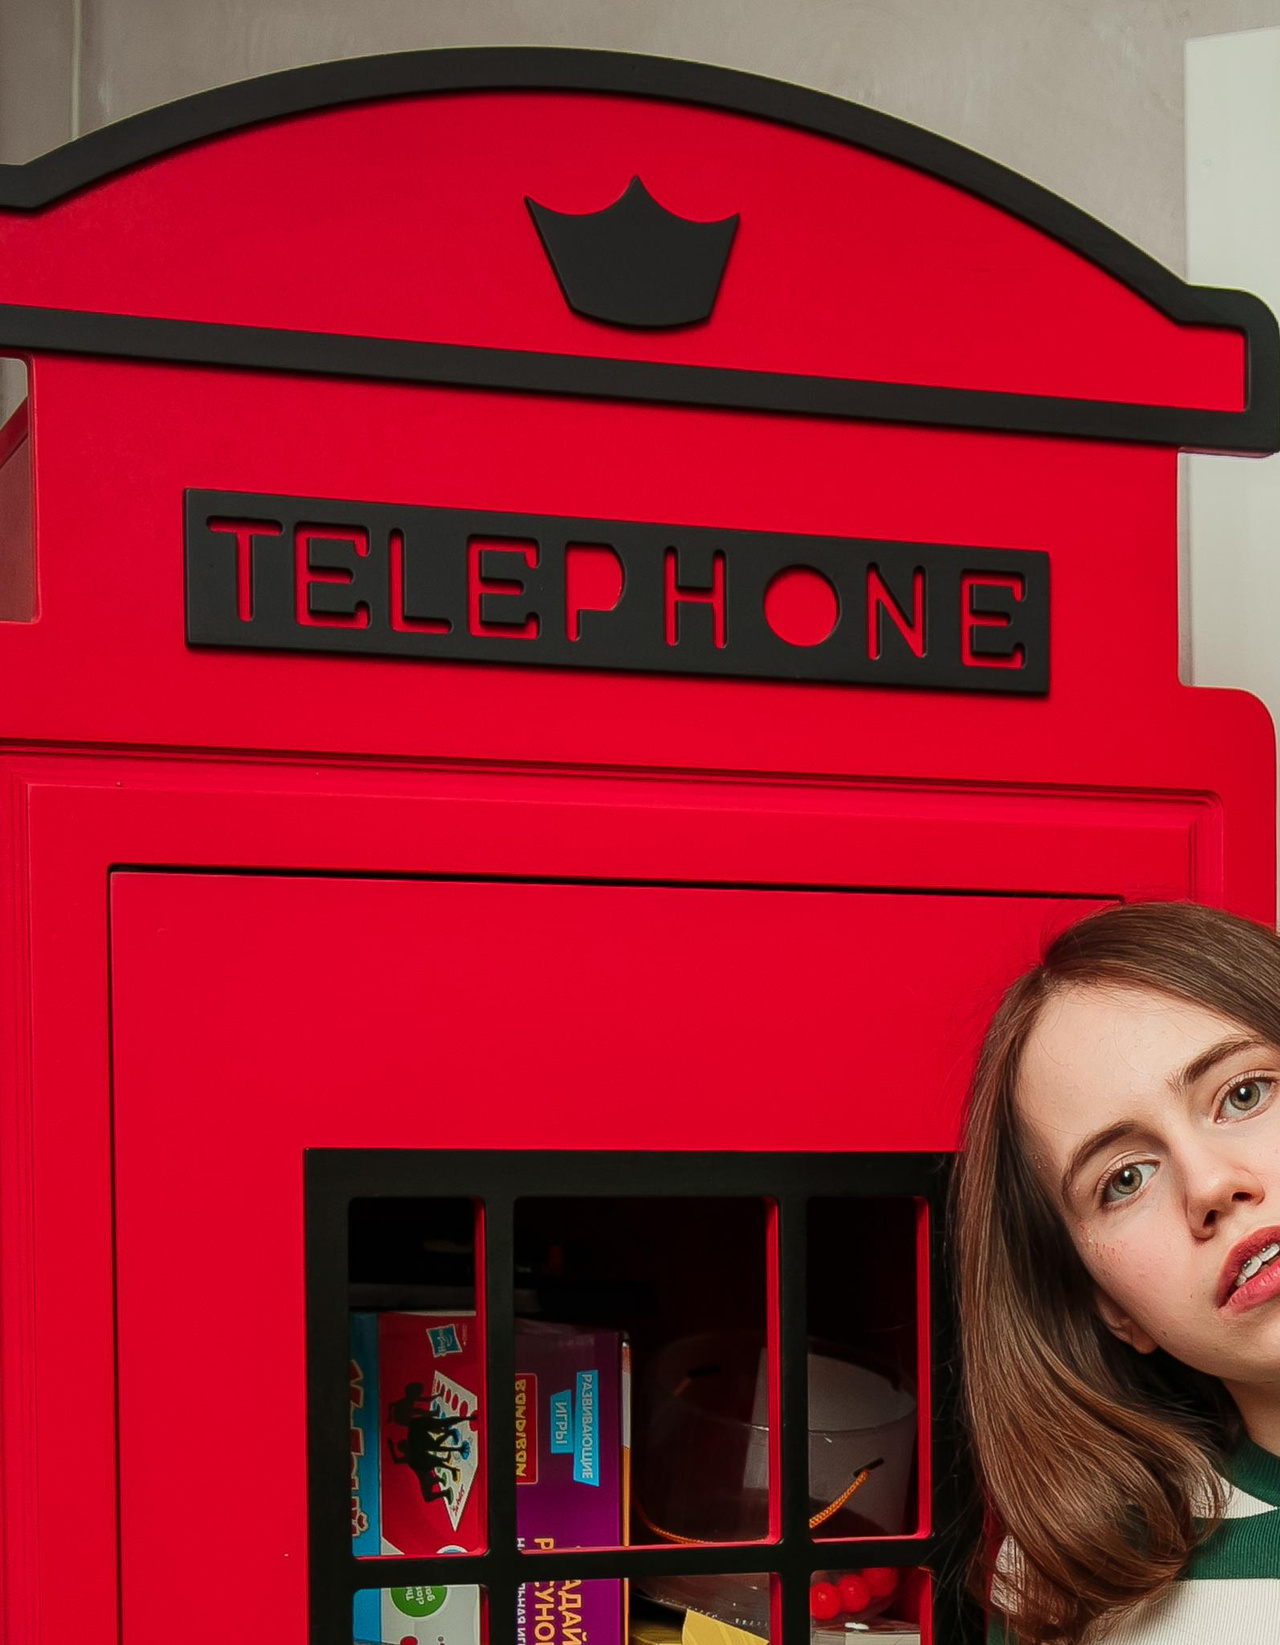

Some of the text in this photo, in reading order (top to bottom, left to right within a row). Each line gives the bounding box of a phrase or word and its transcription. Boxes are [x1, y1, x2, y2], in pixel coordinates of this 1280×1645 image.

[205, 514, 1028, 671] TELEPHONE
[515, 1379, 527, 1477] BONDIBON
[555, 1401, 568, 1444] ИГРЫ
[580, 1373, 594, 1479] РАЗВИВАЮЩИЕ
